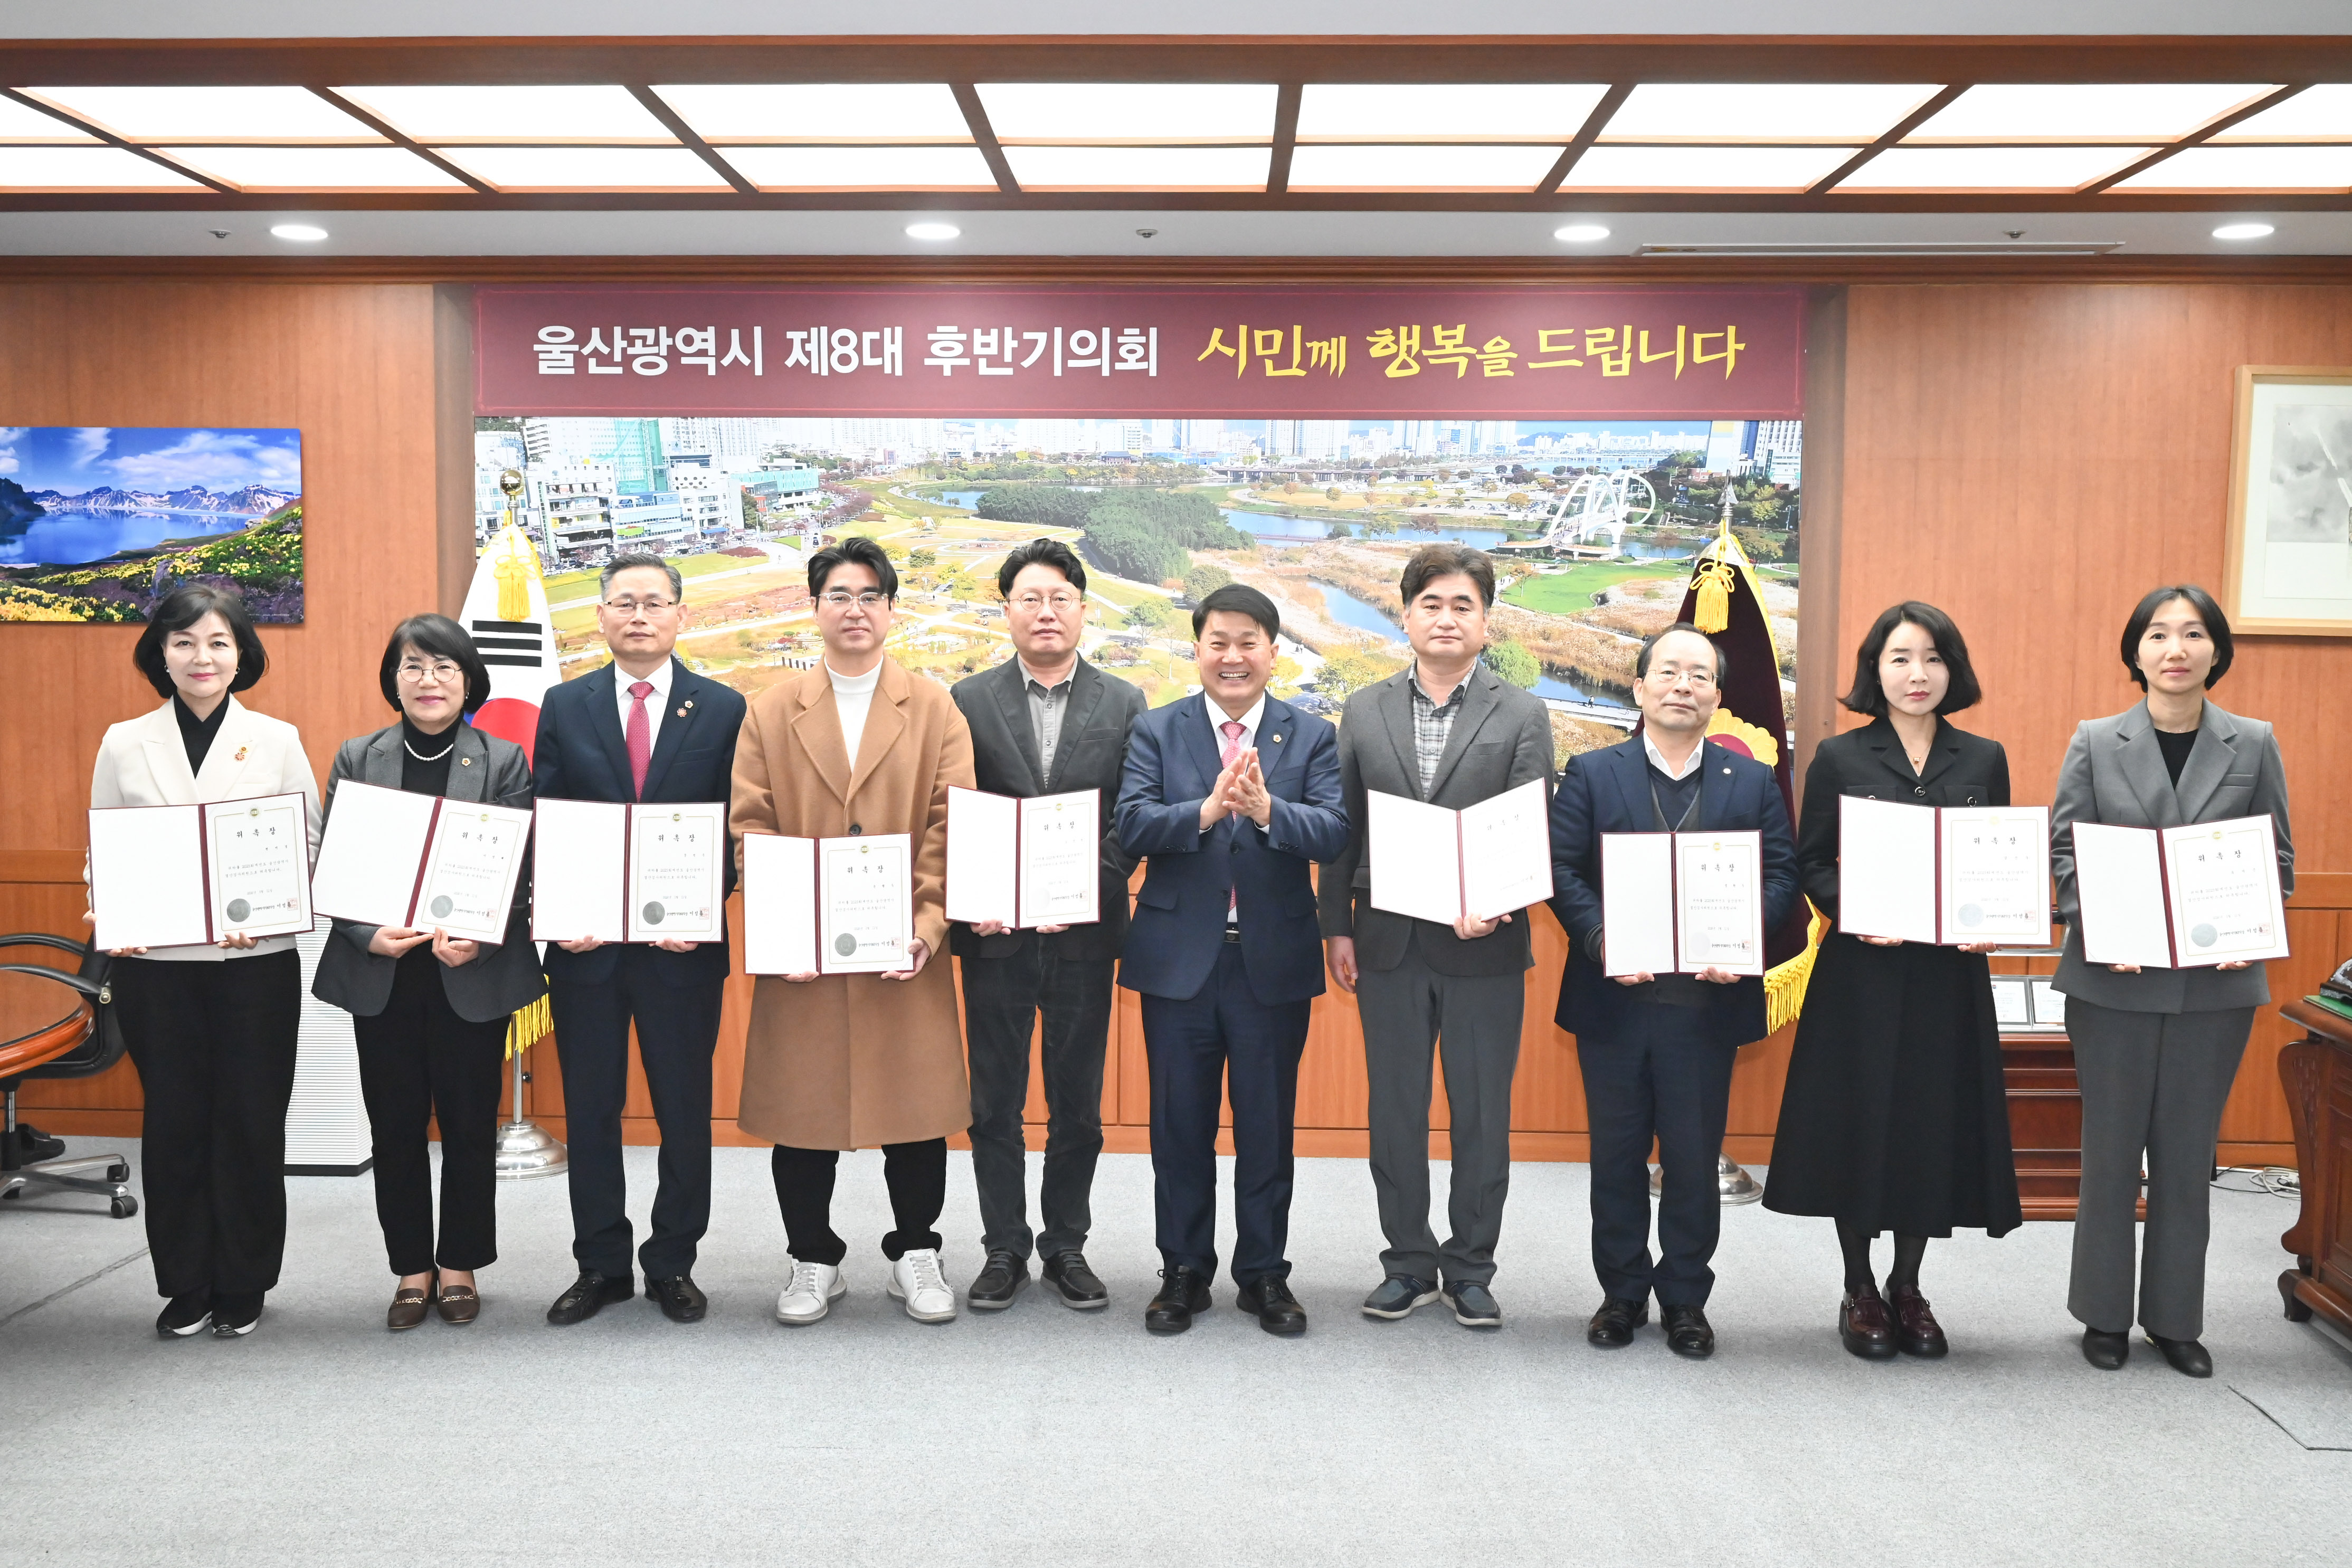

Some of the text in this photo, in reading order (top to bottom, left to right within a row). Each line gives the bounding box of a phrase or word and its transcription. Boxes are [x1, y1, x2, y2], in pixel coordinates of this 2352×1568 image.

[534, 324, 1746, 379] 울산광역시 제8대 후반기의회 시민께 행복을 드립니다
